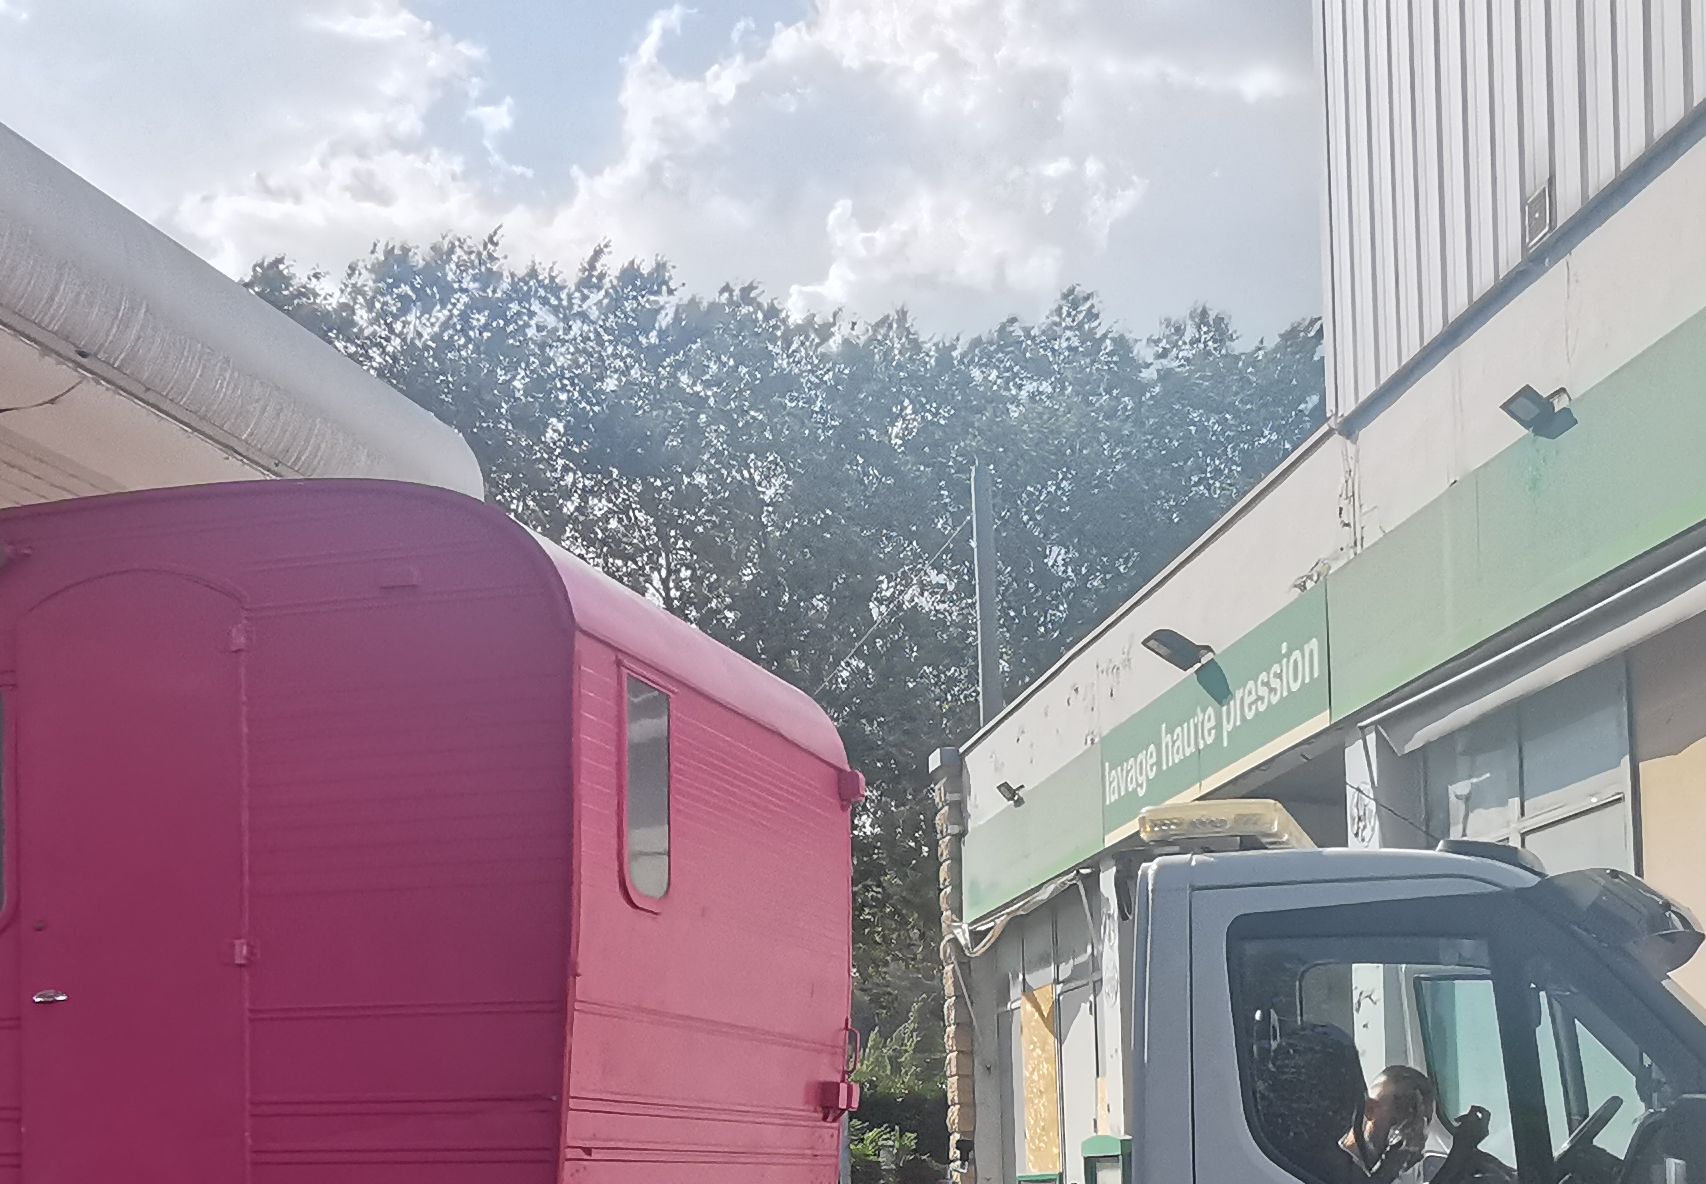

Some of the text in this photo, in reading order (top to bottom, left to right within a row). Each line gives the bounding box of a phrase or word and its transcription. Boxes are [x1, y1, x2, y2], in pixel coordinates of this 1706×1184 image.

[1105, 637, 1320, 805] lavage haute pression
